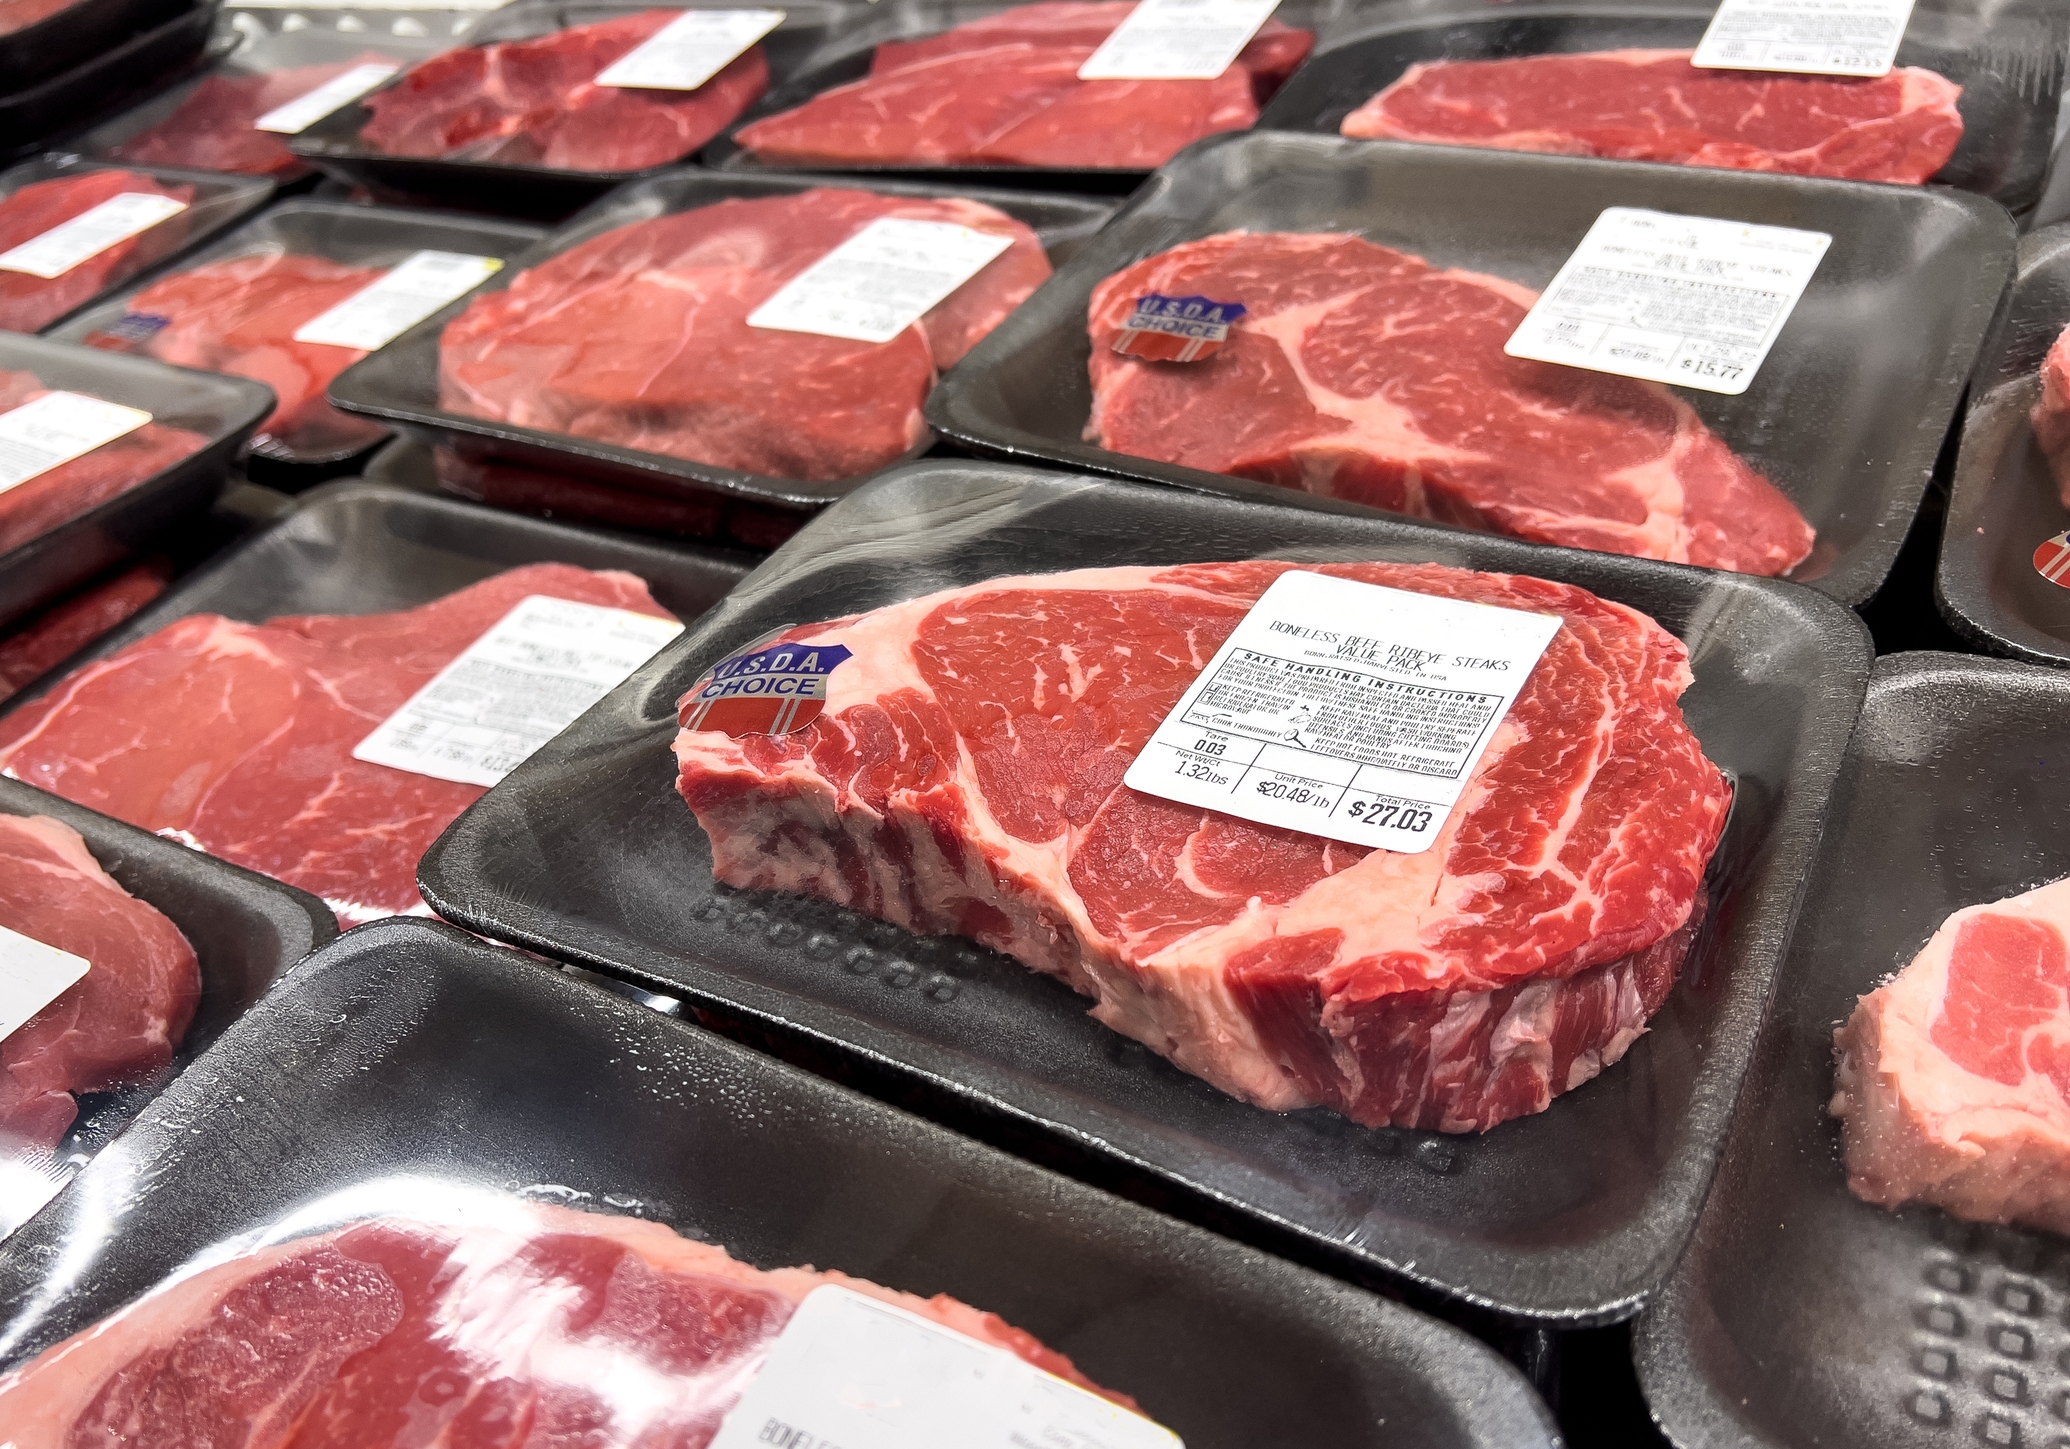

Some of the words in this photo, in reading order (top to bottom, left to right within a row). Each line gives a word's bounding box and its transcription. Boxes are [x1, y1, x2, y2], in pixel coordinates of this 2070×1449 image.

[1140, 298, 1228, 323] U.S.D.A.
[1129, 317, 1219, 338] CHOICE
[1269, 620, 1341, 643] BONELESS
[1344, 635, 1385, 650] BEEF
[1388, 644, 1447, 665] RIBEYE
[1451, 656, 1512, 671] STEAKS
[718, 651, 825, 680] U.S.D.A.
[1336, 644, 1383, 662] VALUE
[1386, 655, 1427, 671] PACK
[702, 677, 819, 699] CHOICE
[1243, 653, 1280, 667] SAFE
[1284, 663, 1362, 683] HANDLING
[1368, 679, 1486, 704] INSTRUCTIONS
[1204, 730, 1229, 742] Tare
[1175, 750, 1193, 760] Net
[1193, 739, 1227, 756] 0.03
[1274, 773, 1297, 784] Unit
[1298, 778, 1324, 790] Price
[1375, 794, 1402, 806] Total
[1402, 799, 1431, 811] Price
[1347, 800, 1433, 833] $27.03
